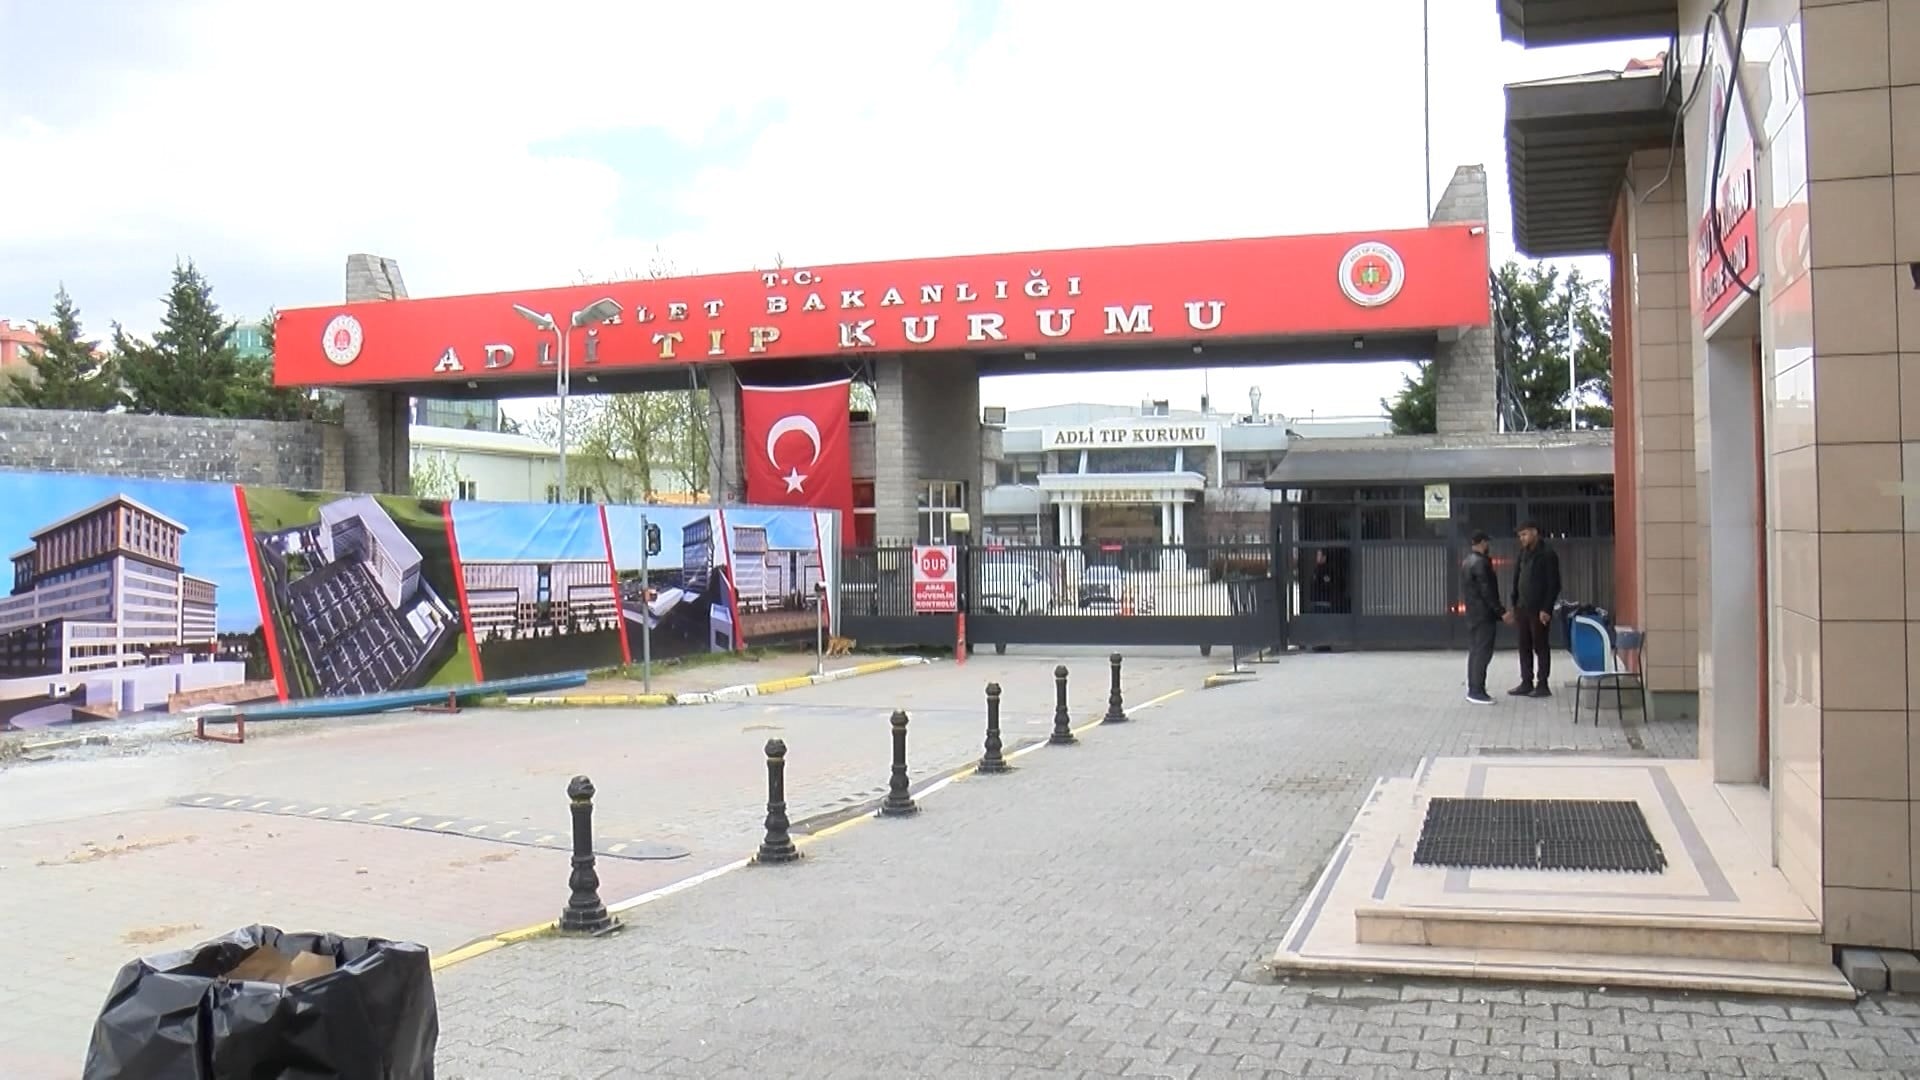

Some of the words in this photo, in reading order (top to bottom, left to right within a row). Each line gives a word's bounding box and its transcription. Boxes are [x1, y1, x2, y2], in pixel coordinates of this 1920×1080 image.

[762, 271, 822, 288] T.C.
[766, 268, 1082, 314] BAKANLIĞI
[433, 328, 601, 373] ADLİ
[652, 326, 782, 359] TIP
[838, 300, 1226, 348] KURUMU
[1055, 427, 1095, 444] ADLİ
[1100, 429, 1127, 443] TIP
[1132, 427, 1206, 443] KURUMU
[923, 558, 947, 571] DUR
